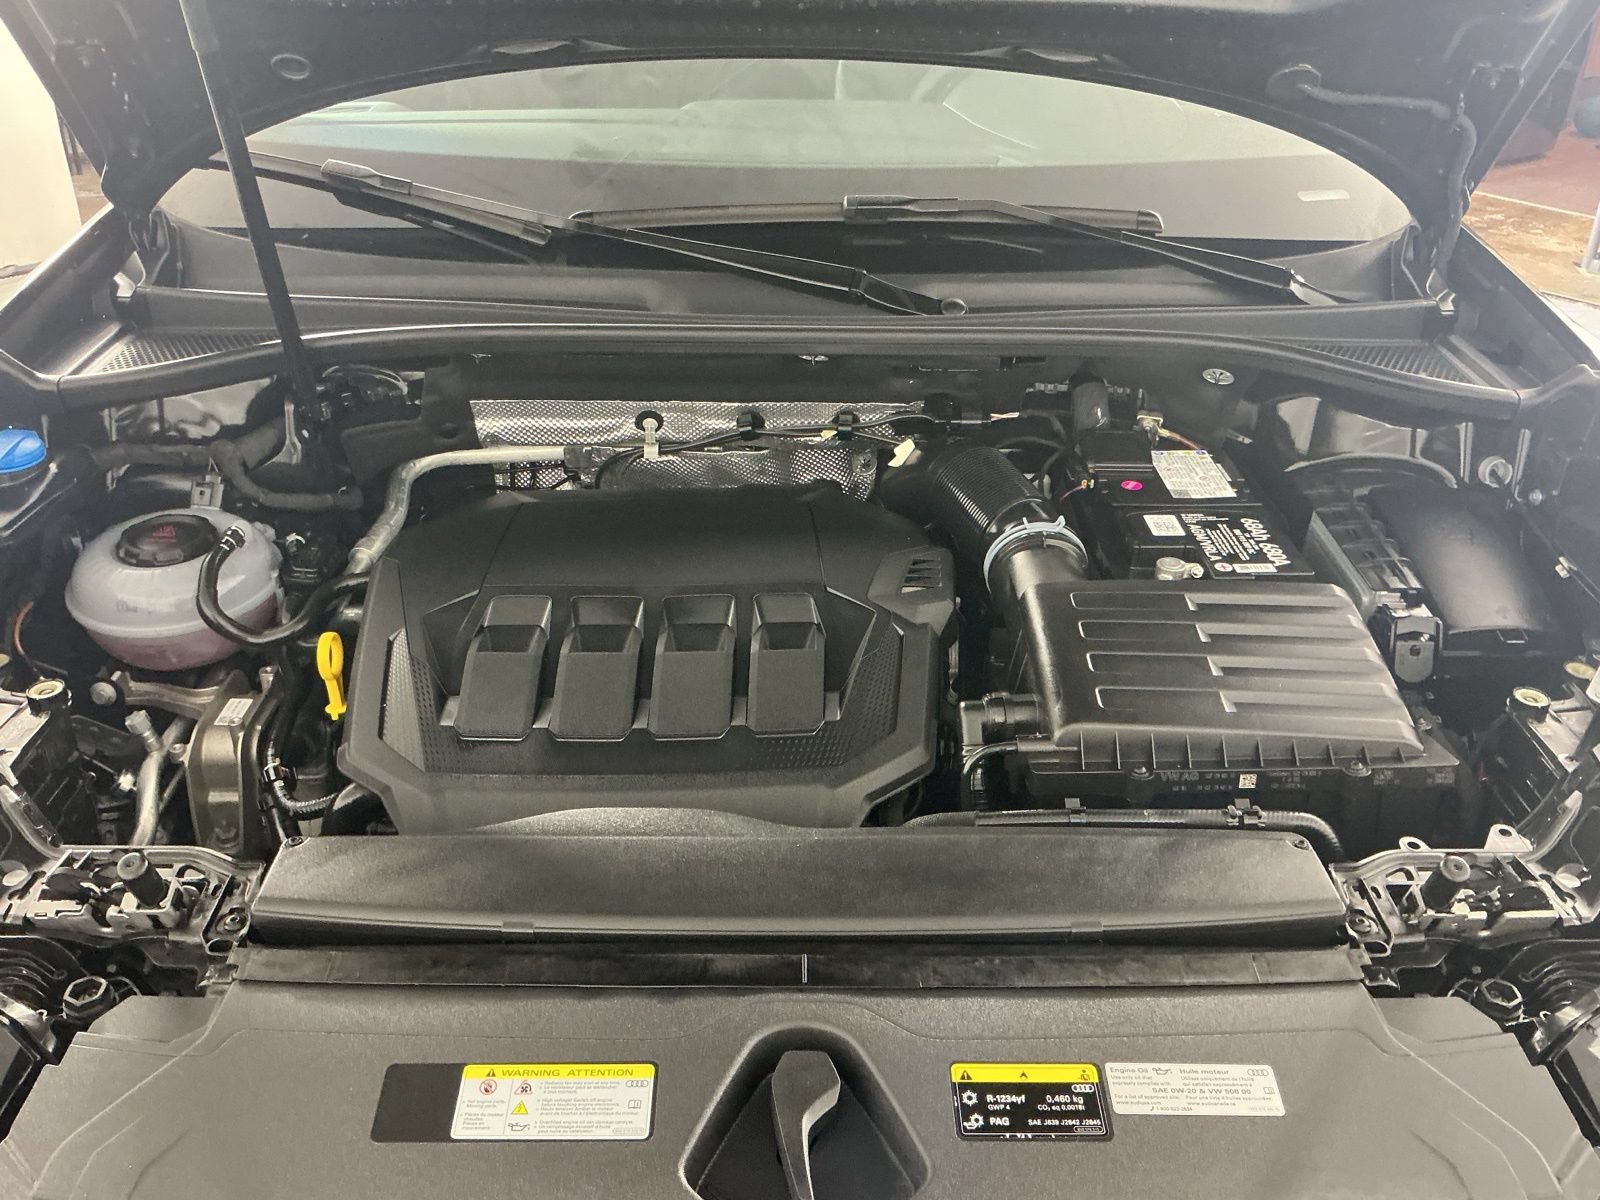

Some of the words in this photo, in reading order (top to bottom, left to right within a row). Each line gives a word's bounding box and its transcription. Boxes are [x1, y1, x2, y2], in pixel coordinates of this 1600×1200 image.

[1240, 518, 1271, 541] 68Ah
[1259, 543, 1291, 567] 680A
[502, 1069, 561, 1077] WARNING
[567, 1069, 634, 1077] ATTENTION
[986, 1094, 1026, 1105] R-1234yf
[1072, 1094, 1084, 1105] kg
[990, 1117, 1010, 1126] PAG
